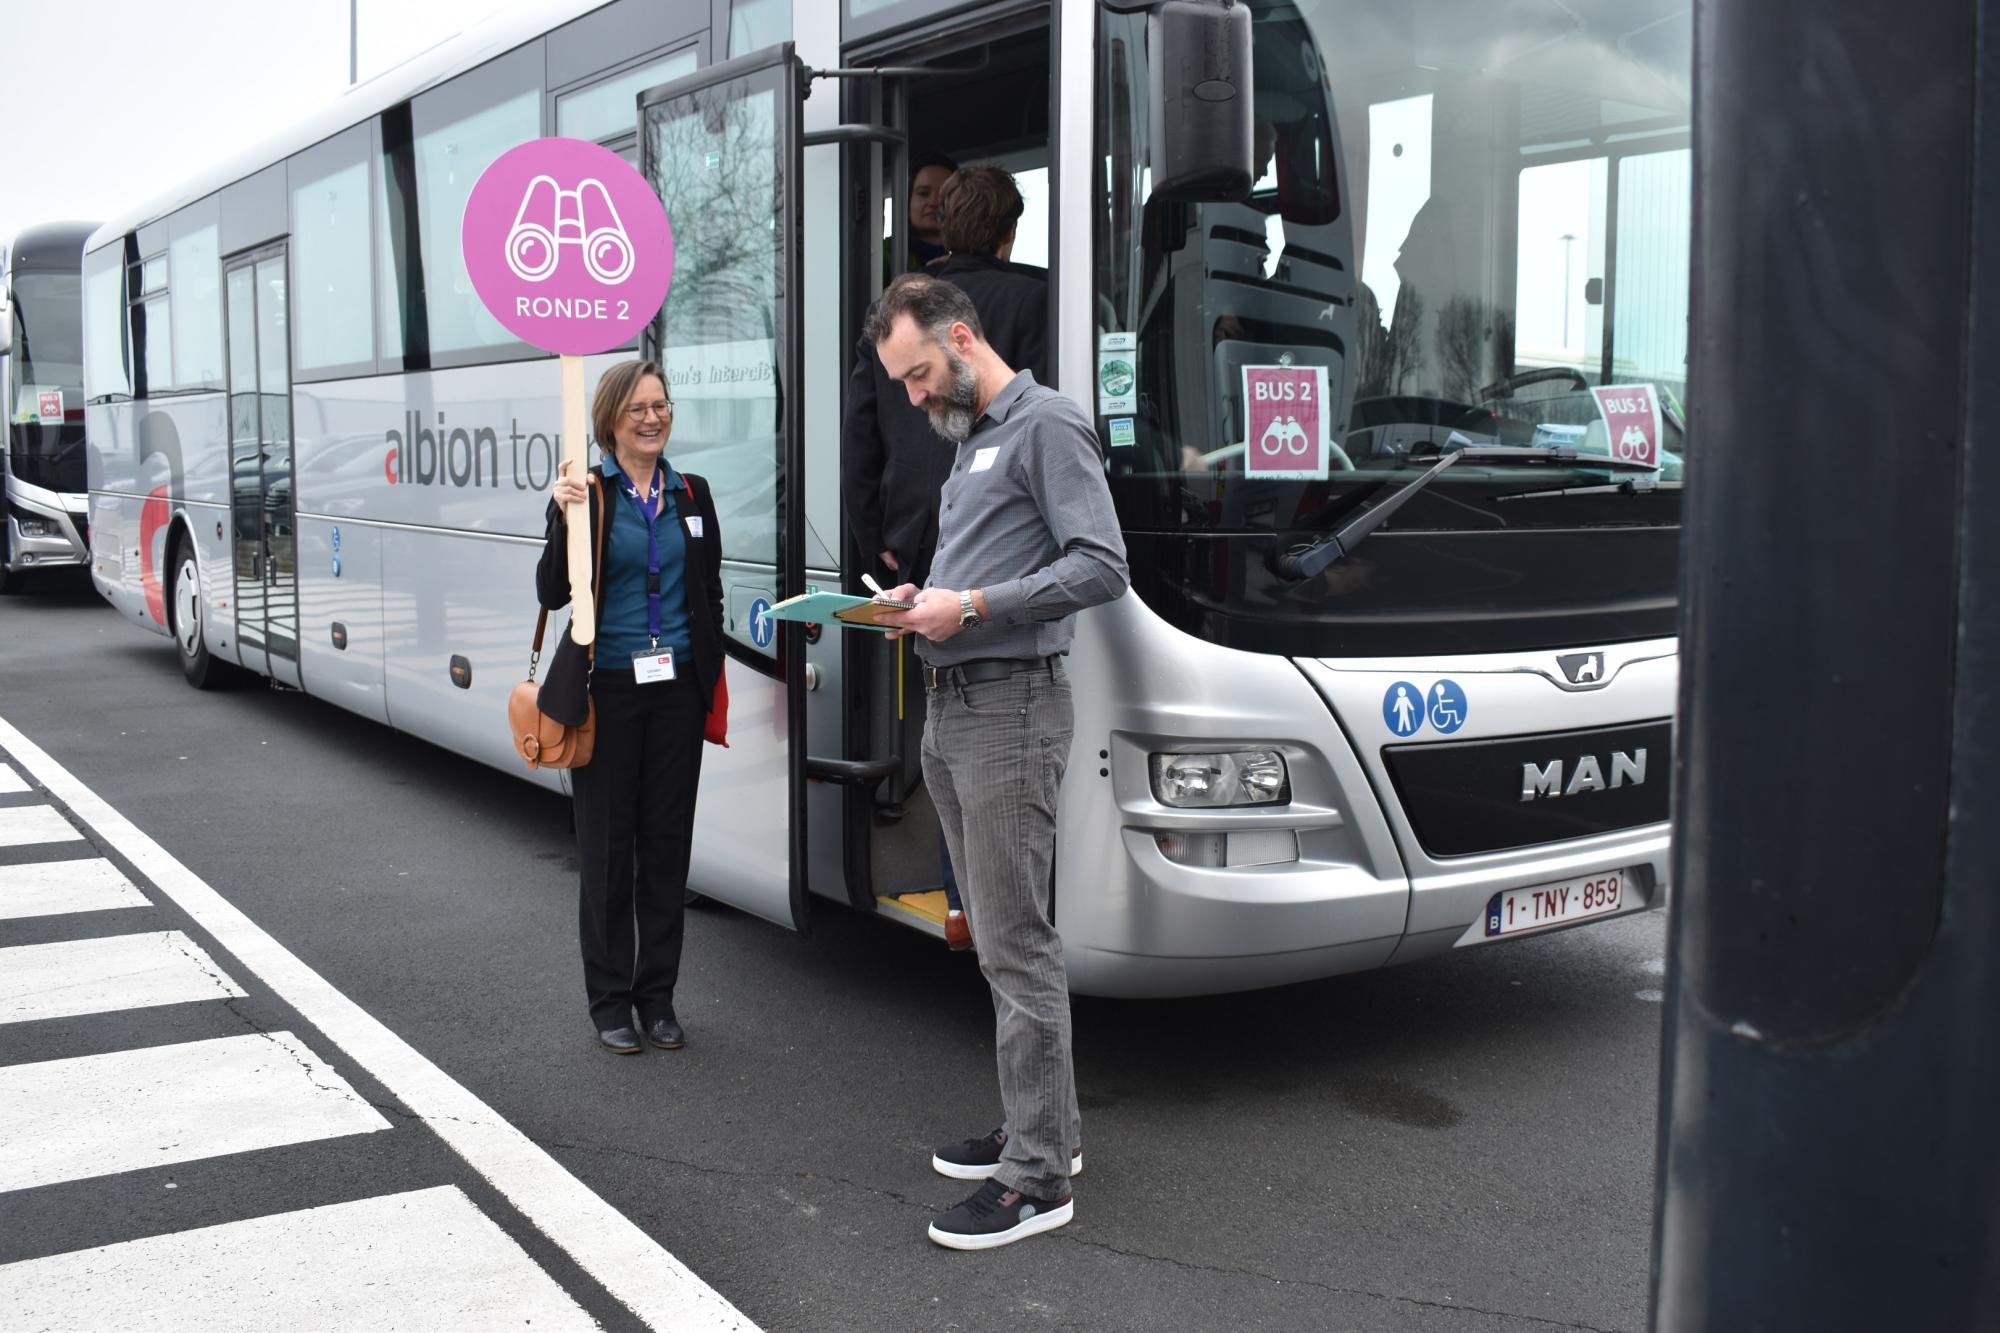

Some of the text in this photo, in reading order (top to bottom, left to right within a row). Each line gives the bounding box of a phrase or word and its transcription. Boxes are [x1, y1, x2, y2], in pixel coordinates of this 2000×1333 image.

[516, 296, 630, 320] RONDE 2
[1255, 381, 1312, 401] BUS 2
[1605, 397, 1648, 414] BUS 2
[385, 410, 499, 488] albion
[1520, 748, 1647, 801] MAN
[1489, 915, 1499, 930] B
